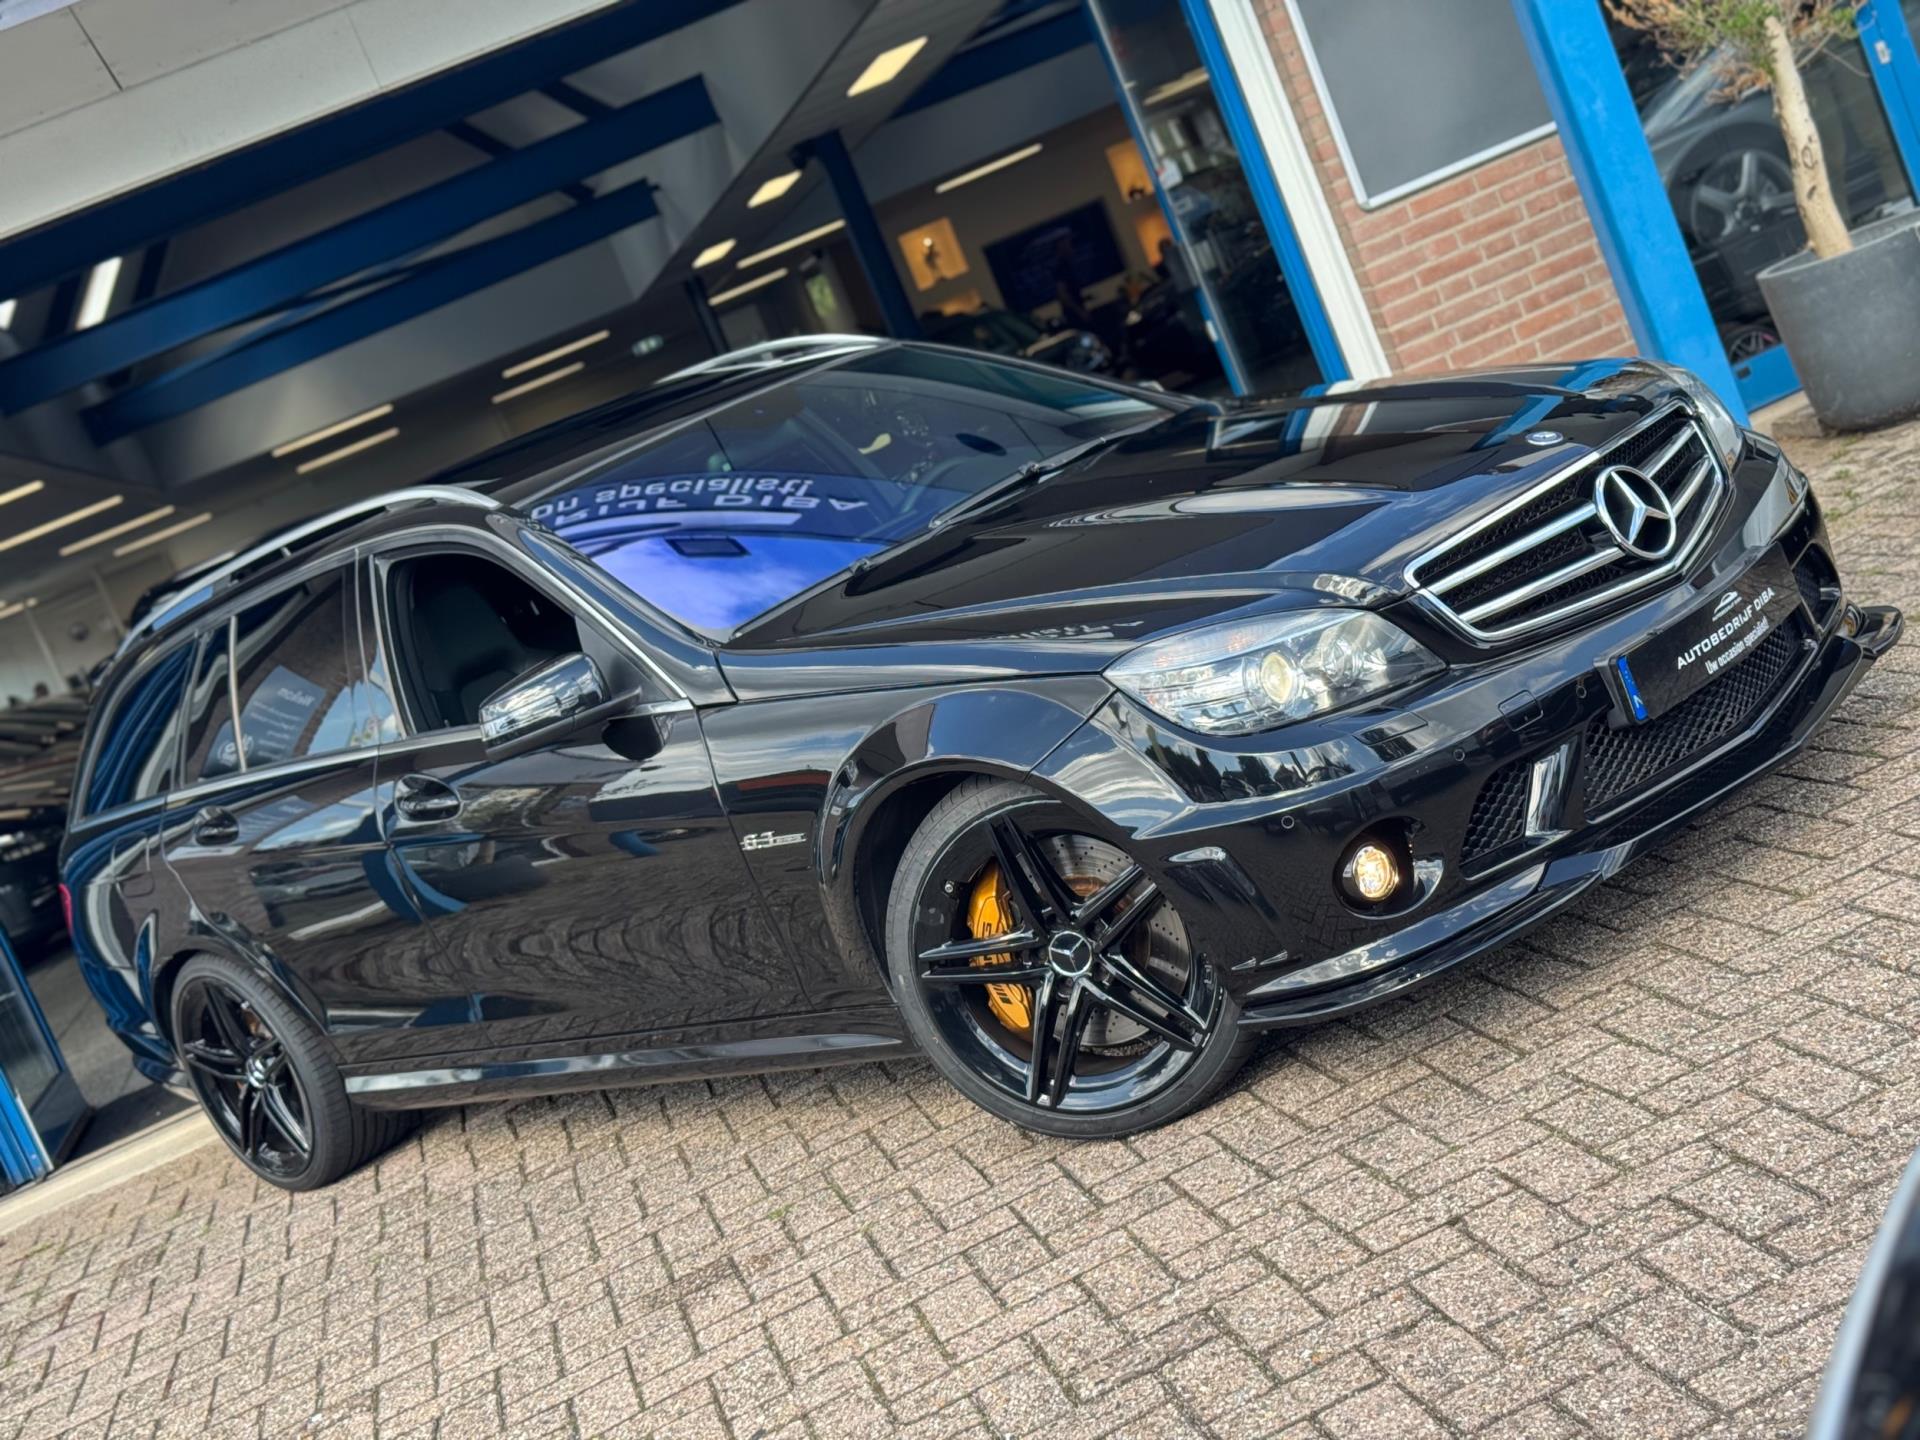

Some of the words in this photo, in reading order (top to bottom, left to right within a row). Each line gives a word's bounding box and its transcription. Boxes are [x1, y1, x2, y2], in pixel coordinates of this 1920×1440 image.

[1677, 604, 1753, 670] AUTOBEDRIJF
[1753, 587, 1775, 611] DIBA
[1705, 660, 1719, 675] Uw
[1717, 640, 1746, 667] occasion
